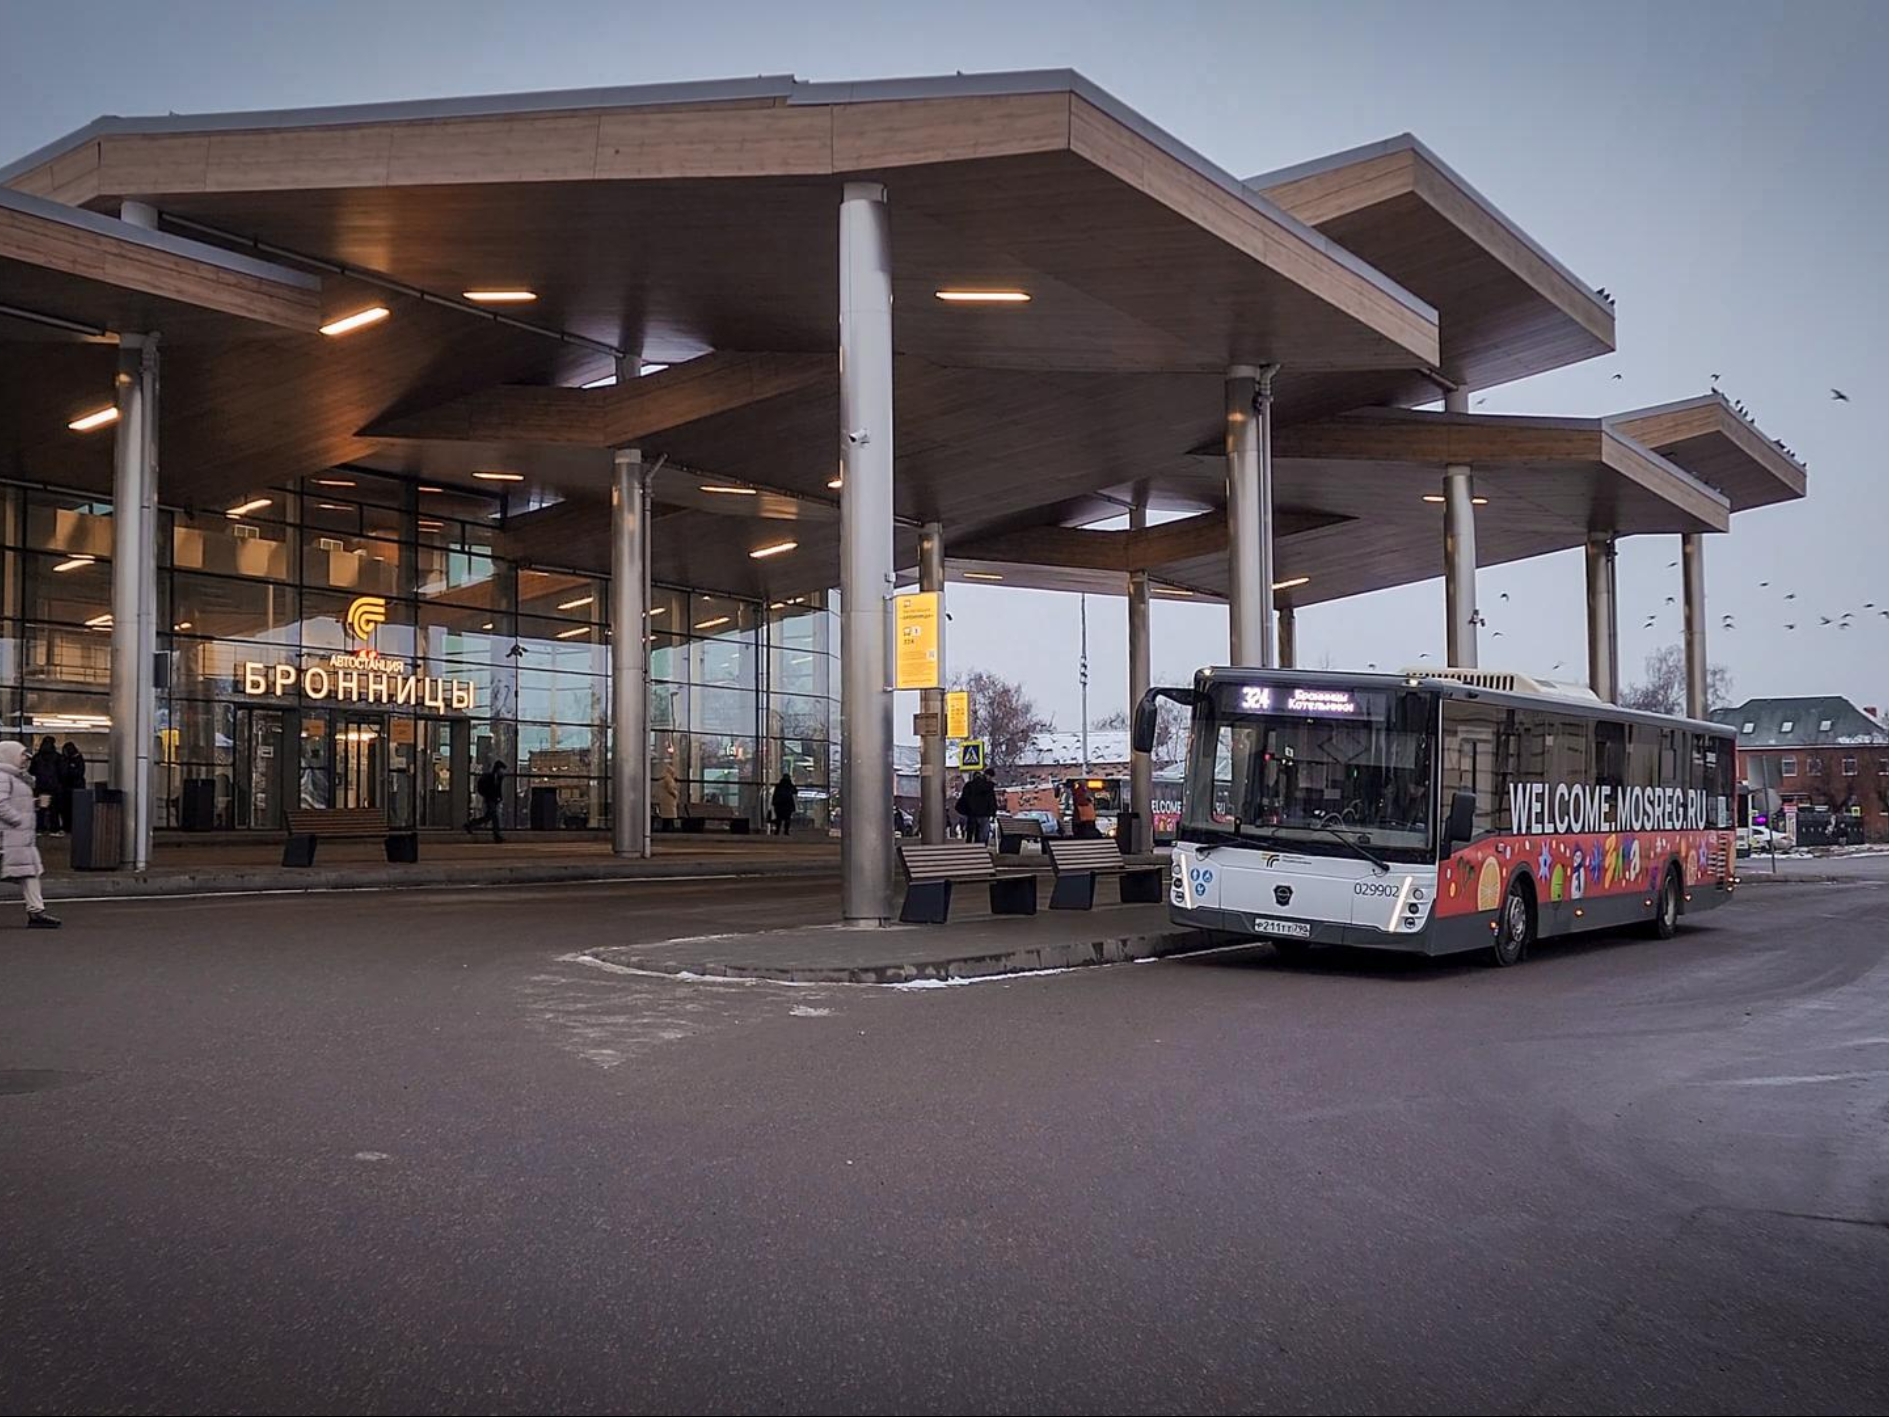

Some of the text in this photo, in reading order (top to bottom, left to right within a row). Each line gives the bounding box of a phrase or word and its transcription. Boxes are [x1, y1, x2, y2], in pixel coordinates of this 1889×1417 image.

[329, 654, 404, 674] АВТОСТАНЦИЯ
[245, 661, 475, 715] БРОННИЦЫ
[1241, 686, 1270, 710] 324
[1151, 800, 1182, 815] ELCOME
[1508, 782, 1708, 835] WELCOME.MOSREG.RU
[1353, 881, 1400, 898] 029902
